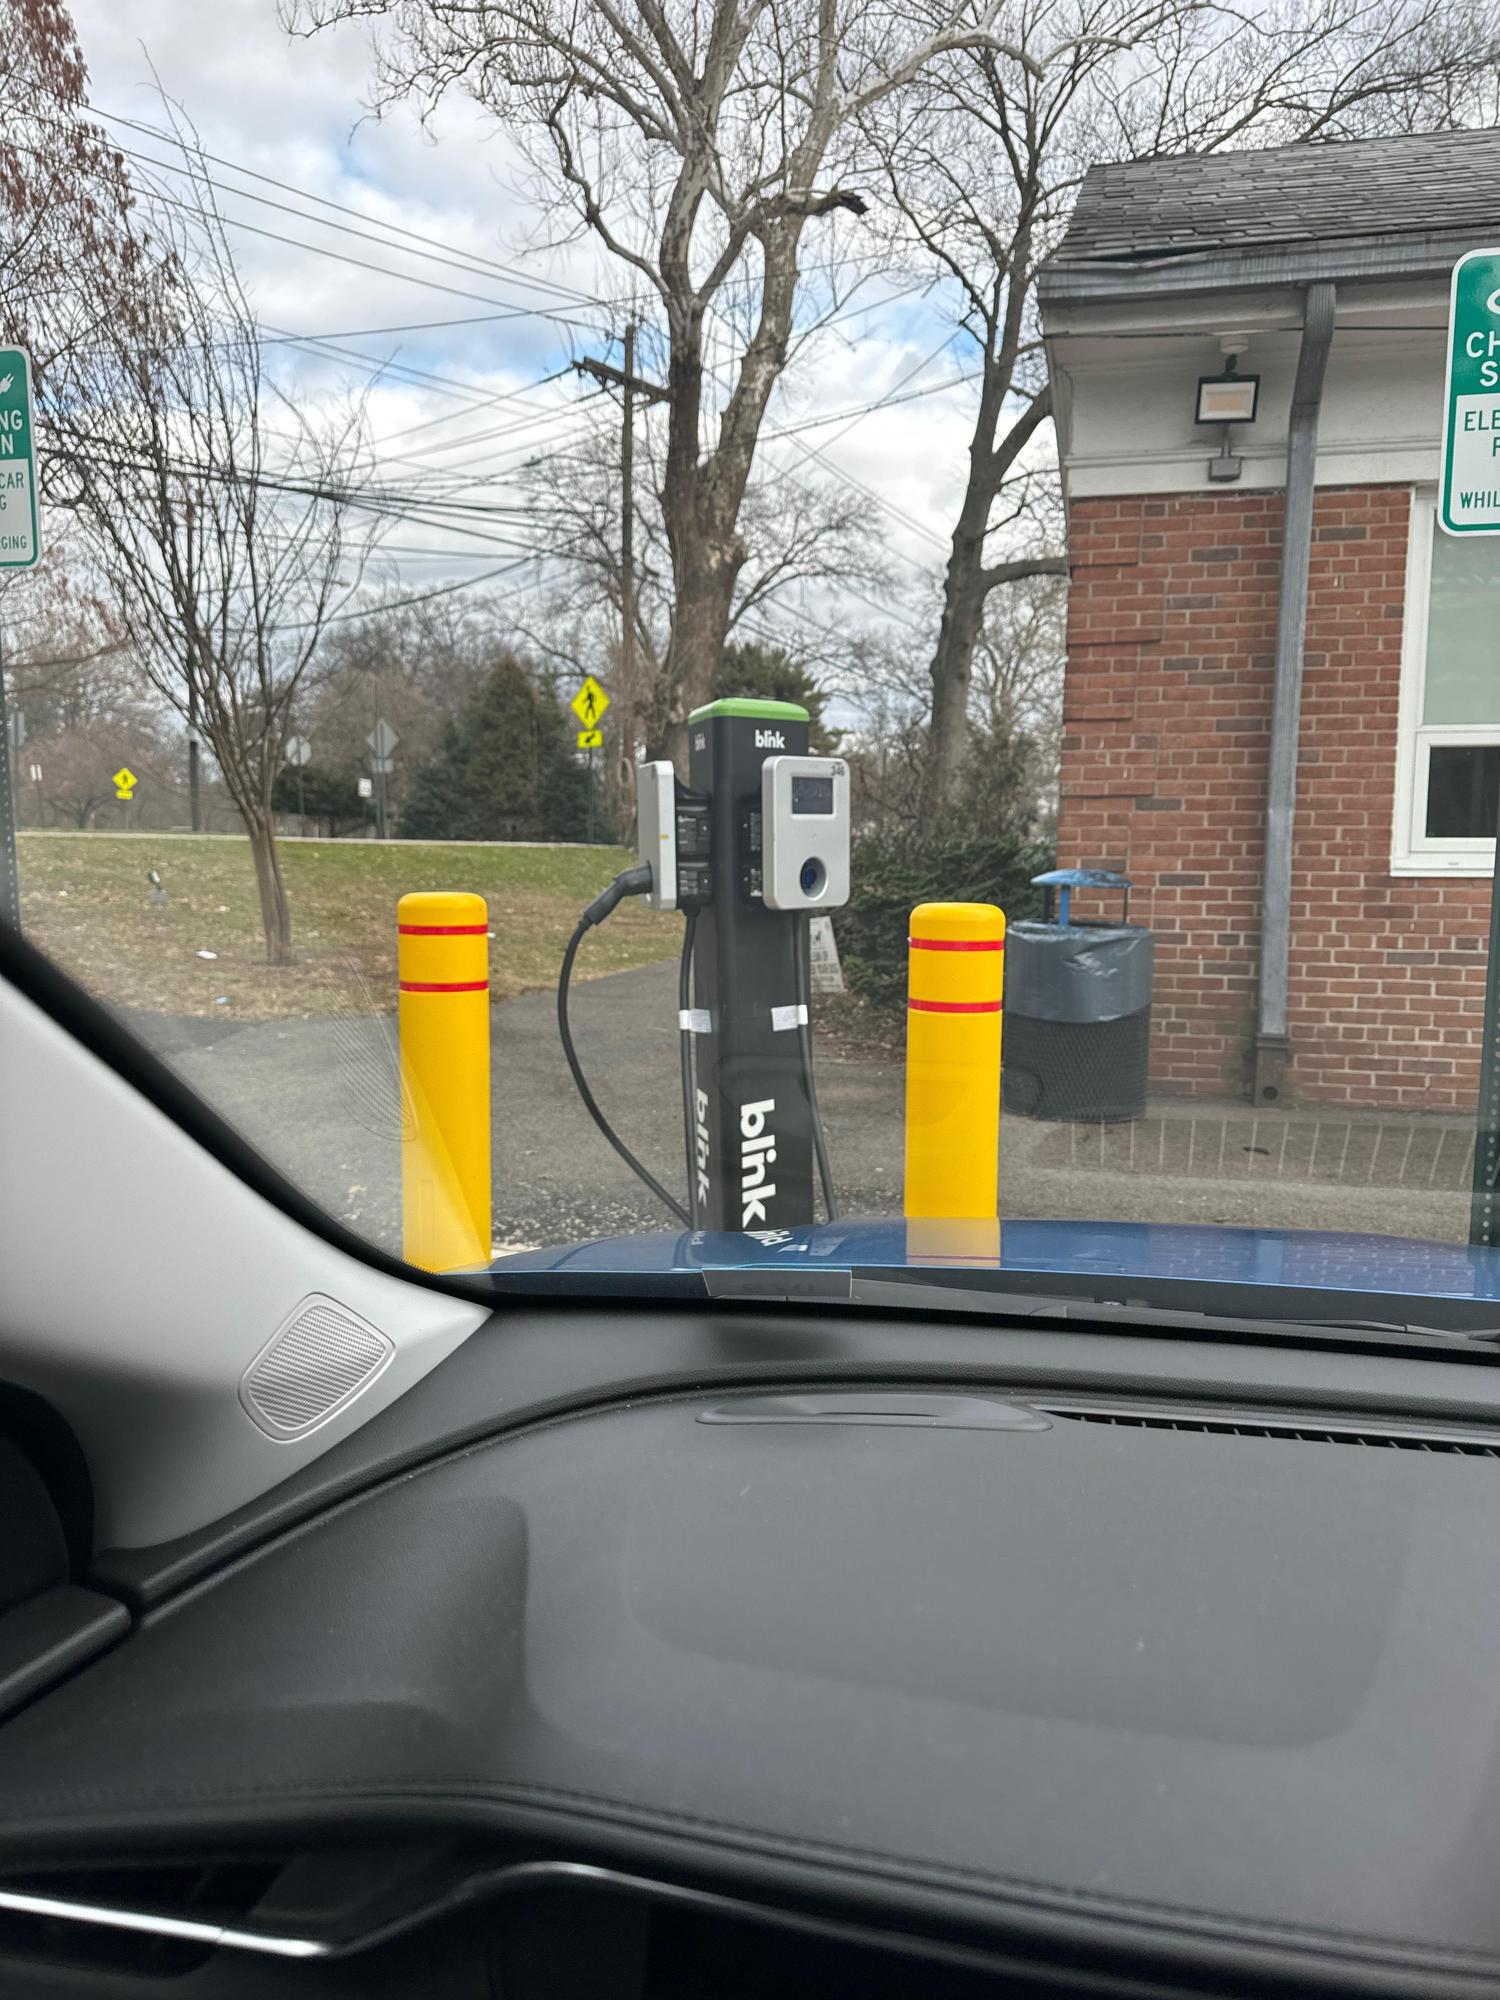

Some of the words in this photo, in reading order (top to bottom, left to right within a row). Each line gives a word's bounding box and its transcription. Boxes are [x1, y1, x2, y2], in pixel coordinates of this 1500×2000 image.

[755, 729, 785, 749] blink
[696, 1088, 710, 1208] blink
[740, 1098, 777, 1229] blink
